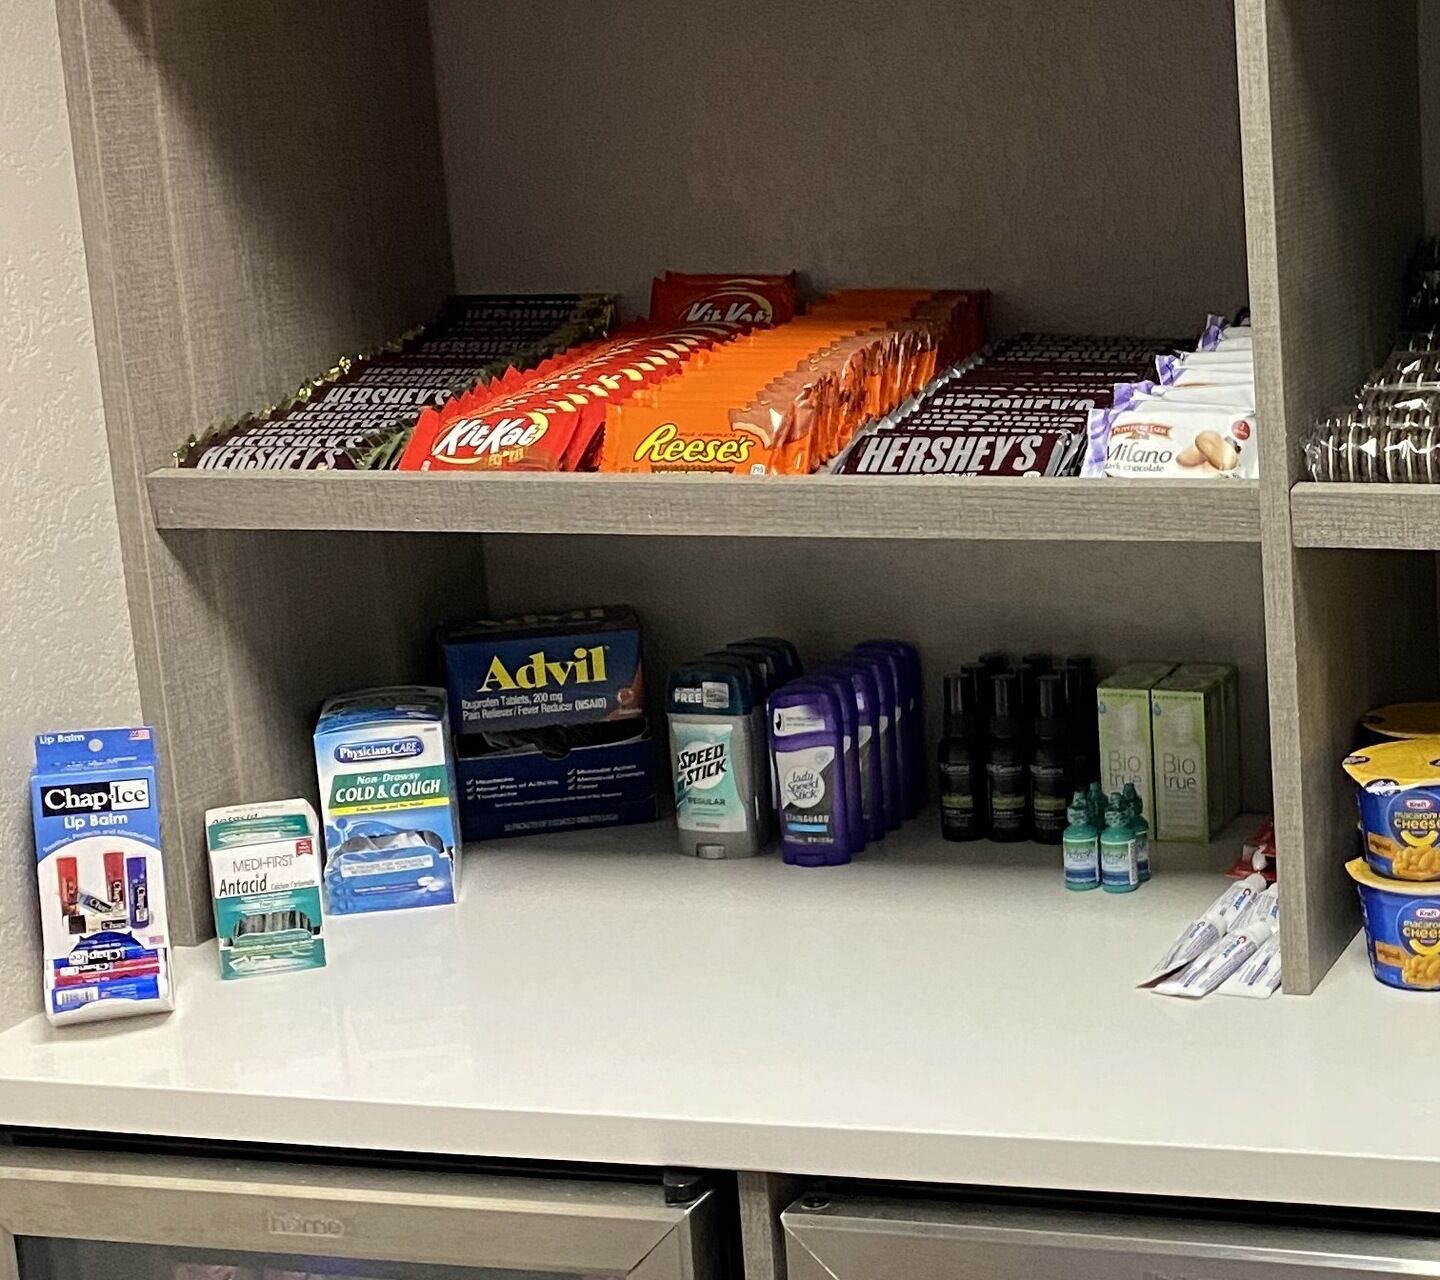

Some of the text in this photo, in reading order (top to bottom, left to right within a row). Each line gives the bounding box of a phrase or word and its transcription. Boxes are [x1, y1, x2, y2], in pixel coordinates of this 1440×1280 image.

[323, 388, 452, 405] HERSHEY'S
[634, 422, 754, 463] Reese's
[1106, 441, 1173, 464] Milano
[857, 435, 1044, 474] HERSHEY'S
[477, 645, 608, 692] Advil
[461, 693, 564, 711] Ibuprofen Tablets, 200 mg
[674, 691, 702, 704] FREE
[462, 697, 608, 721] Pain Reducer (NSAID)
[39, 732, 86, 745] Lip Balm
[680, 743, 725, 770] SPEED
[1109, 750, 1142, 772] Bio
[1163, 752, 1196, 774] Bio
[356, 771, 420, 785] Non-Drowsy
[686, 758, 727, 787] STICK
[1163, 773, 1197, 791] true
[336, 778, 441, 803] COLD & COUGH
[687, 796, 726, 807] REGULAR
[64, 813, 129, 831] Lip Balm
[233, 855, 294, 873] MEDI-FIRST
[219, 873, 267, 897] Antacid
